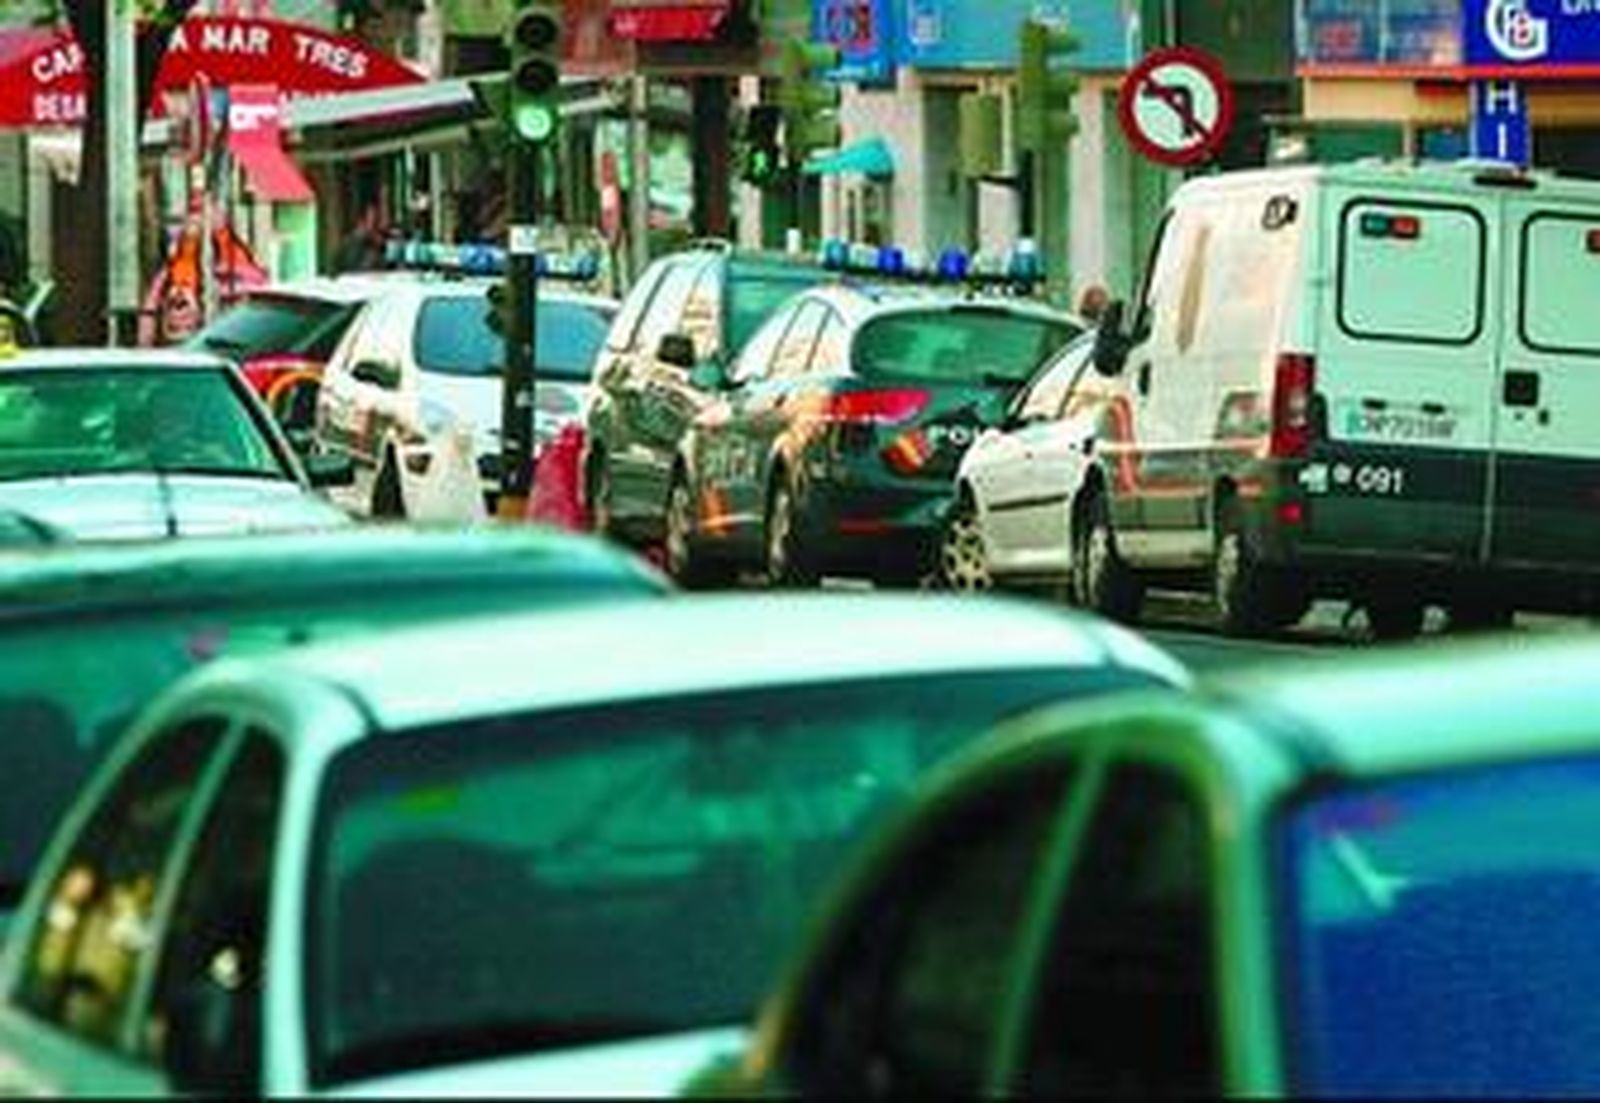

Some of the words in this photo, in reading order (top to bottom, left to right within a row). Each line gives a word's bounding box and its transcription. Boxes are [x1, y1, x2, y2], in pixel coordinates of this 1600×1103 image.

[202, 24, 270, 54] MAR
[294, 34, 369, 78] TRES
[1356, 465, 1403, 494] 091
